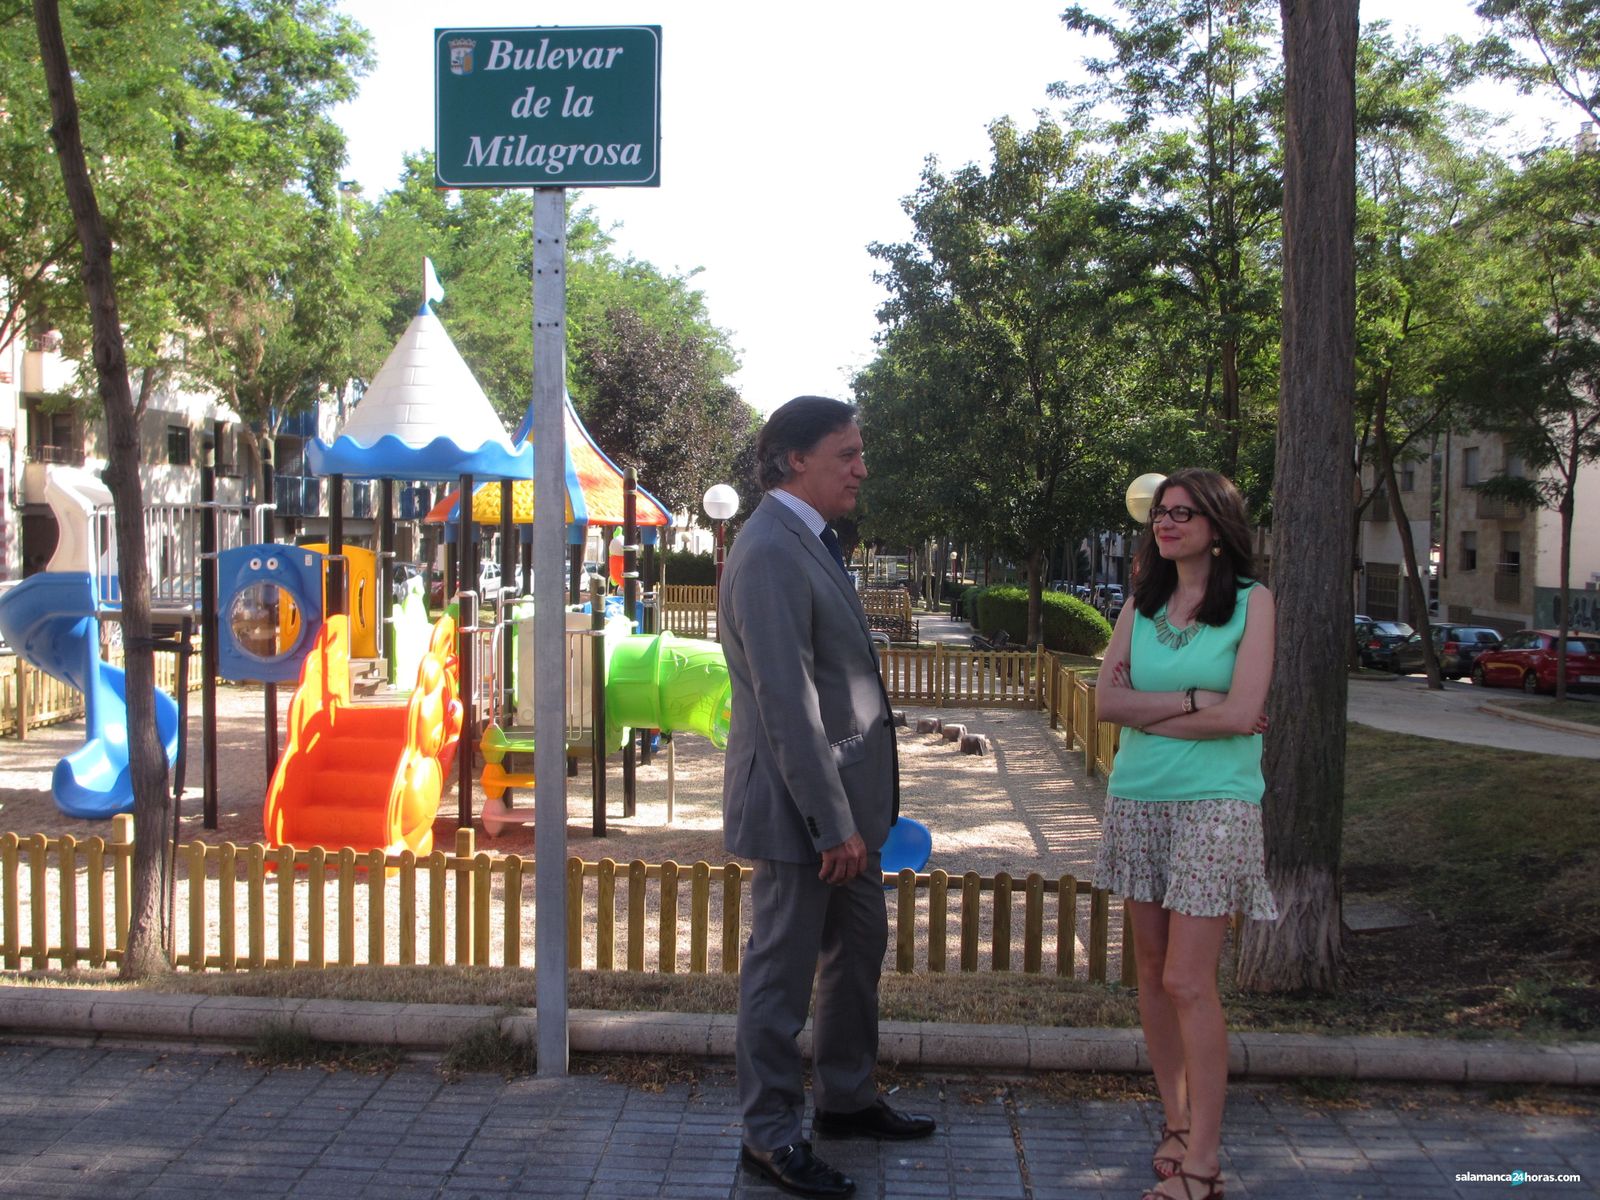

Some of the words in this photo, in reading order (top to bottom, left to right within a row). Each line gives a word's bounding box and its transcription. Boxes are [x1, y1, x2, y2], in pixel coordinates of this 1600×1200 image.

[484, 38, 624, 71] Bulevar
[511, 86, 551, 118] de
[561, 86, 594, 117] la
[463, 135, 642, 174] Milagrosa
